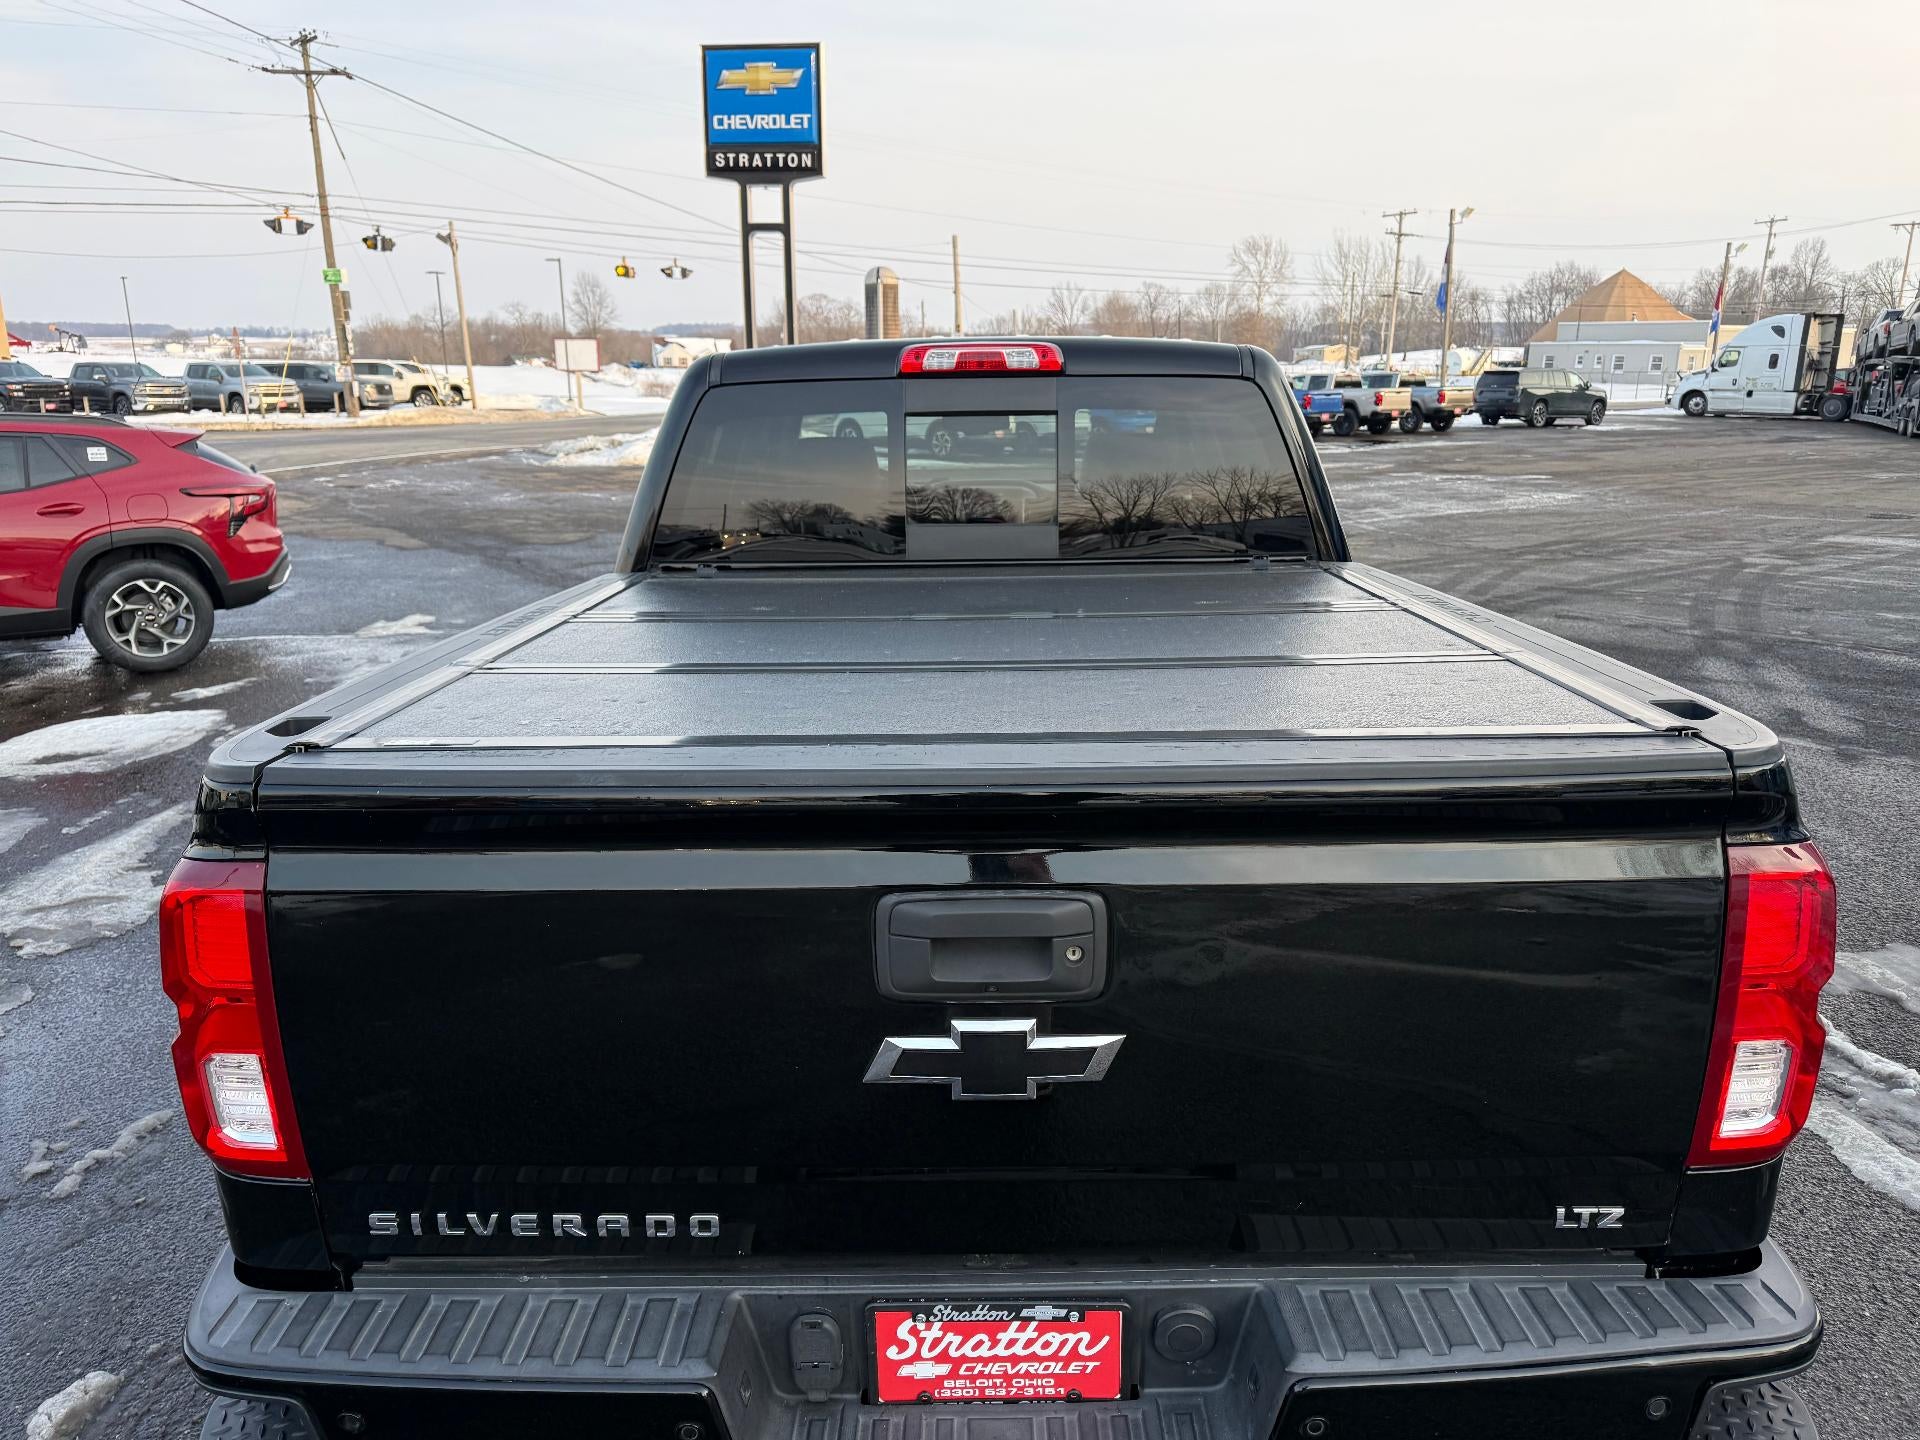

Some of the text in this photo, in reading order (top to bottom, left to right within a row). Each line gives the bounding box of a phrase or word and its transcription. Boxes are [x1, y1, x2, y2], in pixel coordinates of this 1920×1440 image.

[713, 114, 811, 129] CHEVROLET
[715, 153, 812, 168] STRATTON
[368, 1211, 720, 1237] SILVERADO
[1555, 1206, 1625, 1228] LTZ
[929, 1305, 1015, 1322] Stratton
[886, 1320, 1110, 1360] Stratton
[958, 1361, 1101, 1375] CHEVROLET
[1012, 1378, 1055, 1387] OHIO
[934, 1388, 979, 1397] (330)
